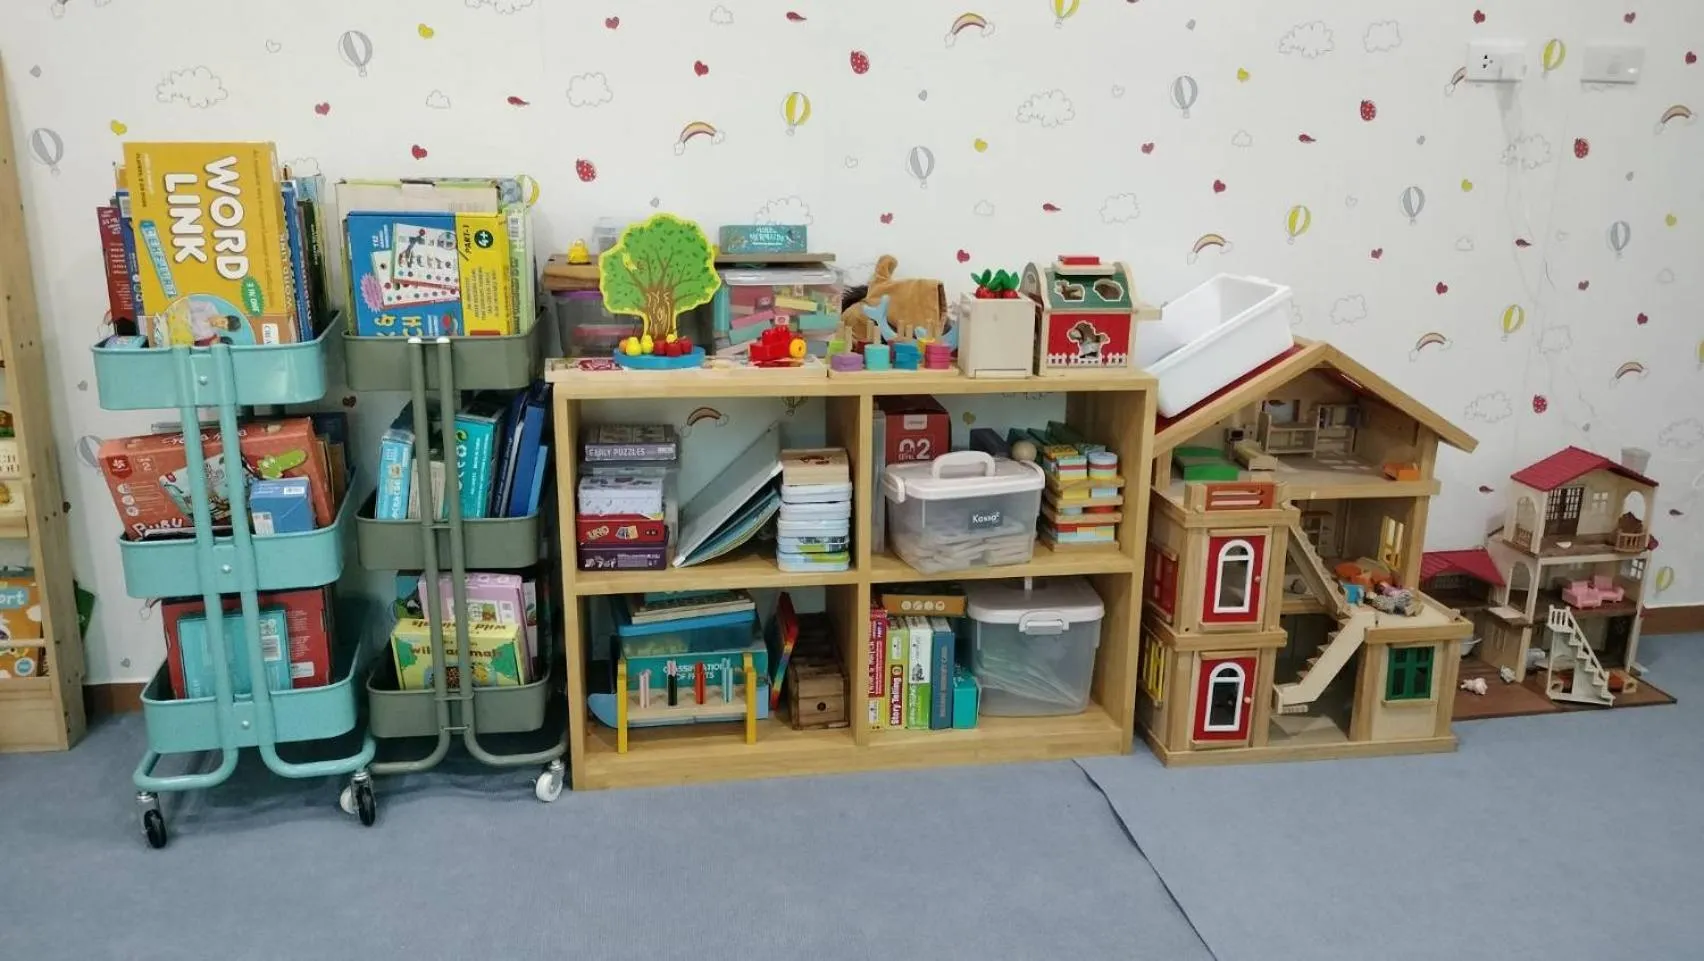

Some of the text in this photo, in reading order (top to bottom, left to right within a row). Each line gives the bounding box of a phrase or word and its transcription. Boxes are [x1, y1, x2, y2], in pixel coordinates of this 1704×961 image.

[164, 172, 208, 264] LINK
[204, 155, 249, 280] WORD
[462, 224, 472, 254] PART-1
[477, 231, 489, 246] 4+
[612, 446, 646, 457] PUZZLES
[890, 677, 902, 725] Story Telling
